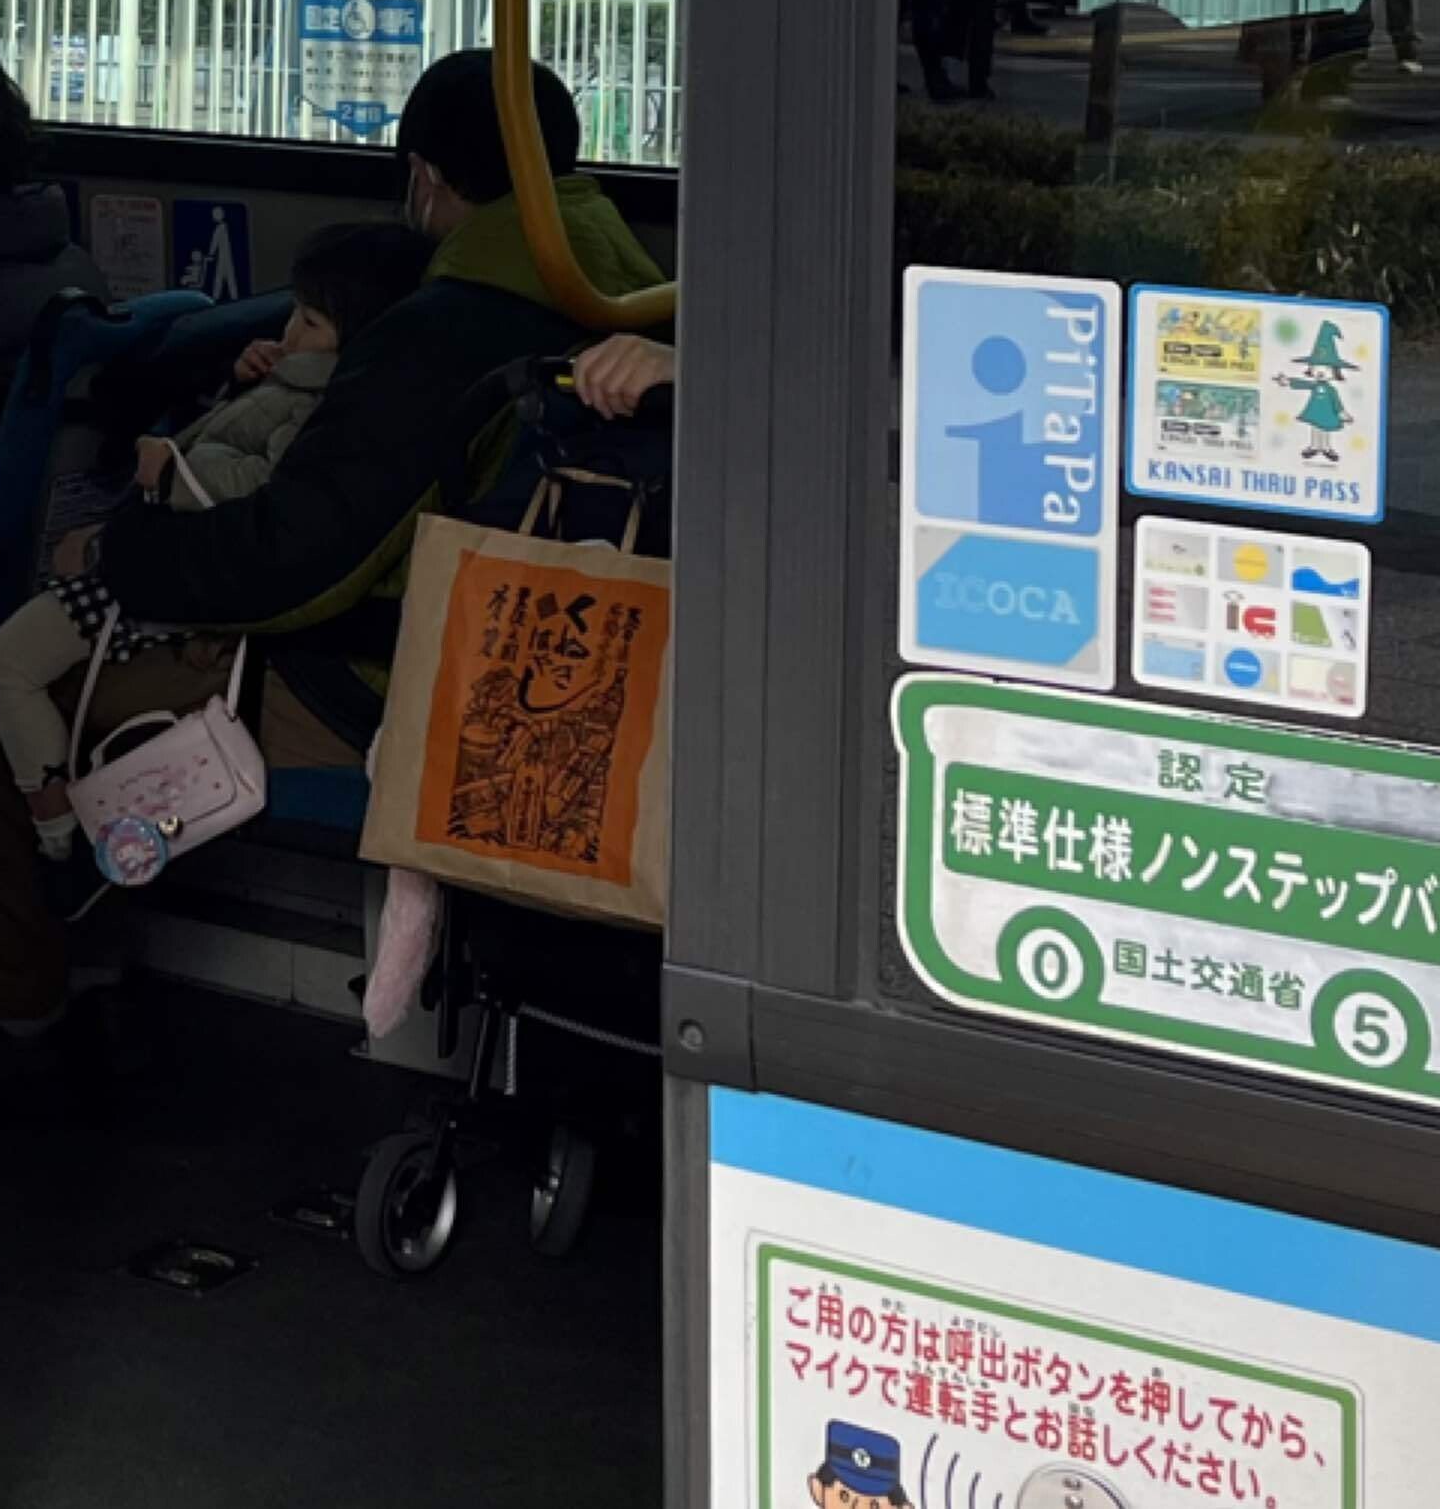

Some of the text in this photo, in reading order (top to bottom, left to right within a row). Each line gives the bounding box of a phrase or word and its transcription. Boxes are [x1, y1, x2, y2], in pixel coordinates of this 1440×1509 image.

[1042, 304, 1099, 524] PiTaPa
[1147, 458, 1361, 505] KANSAI THRU PASS
[933, 571, 1082, 626] ICOCA
[1113, 937, 1306, 1011] 国土交通省
[1350, 1006, 1390, 1057] 5
